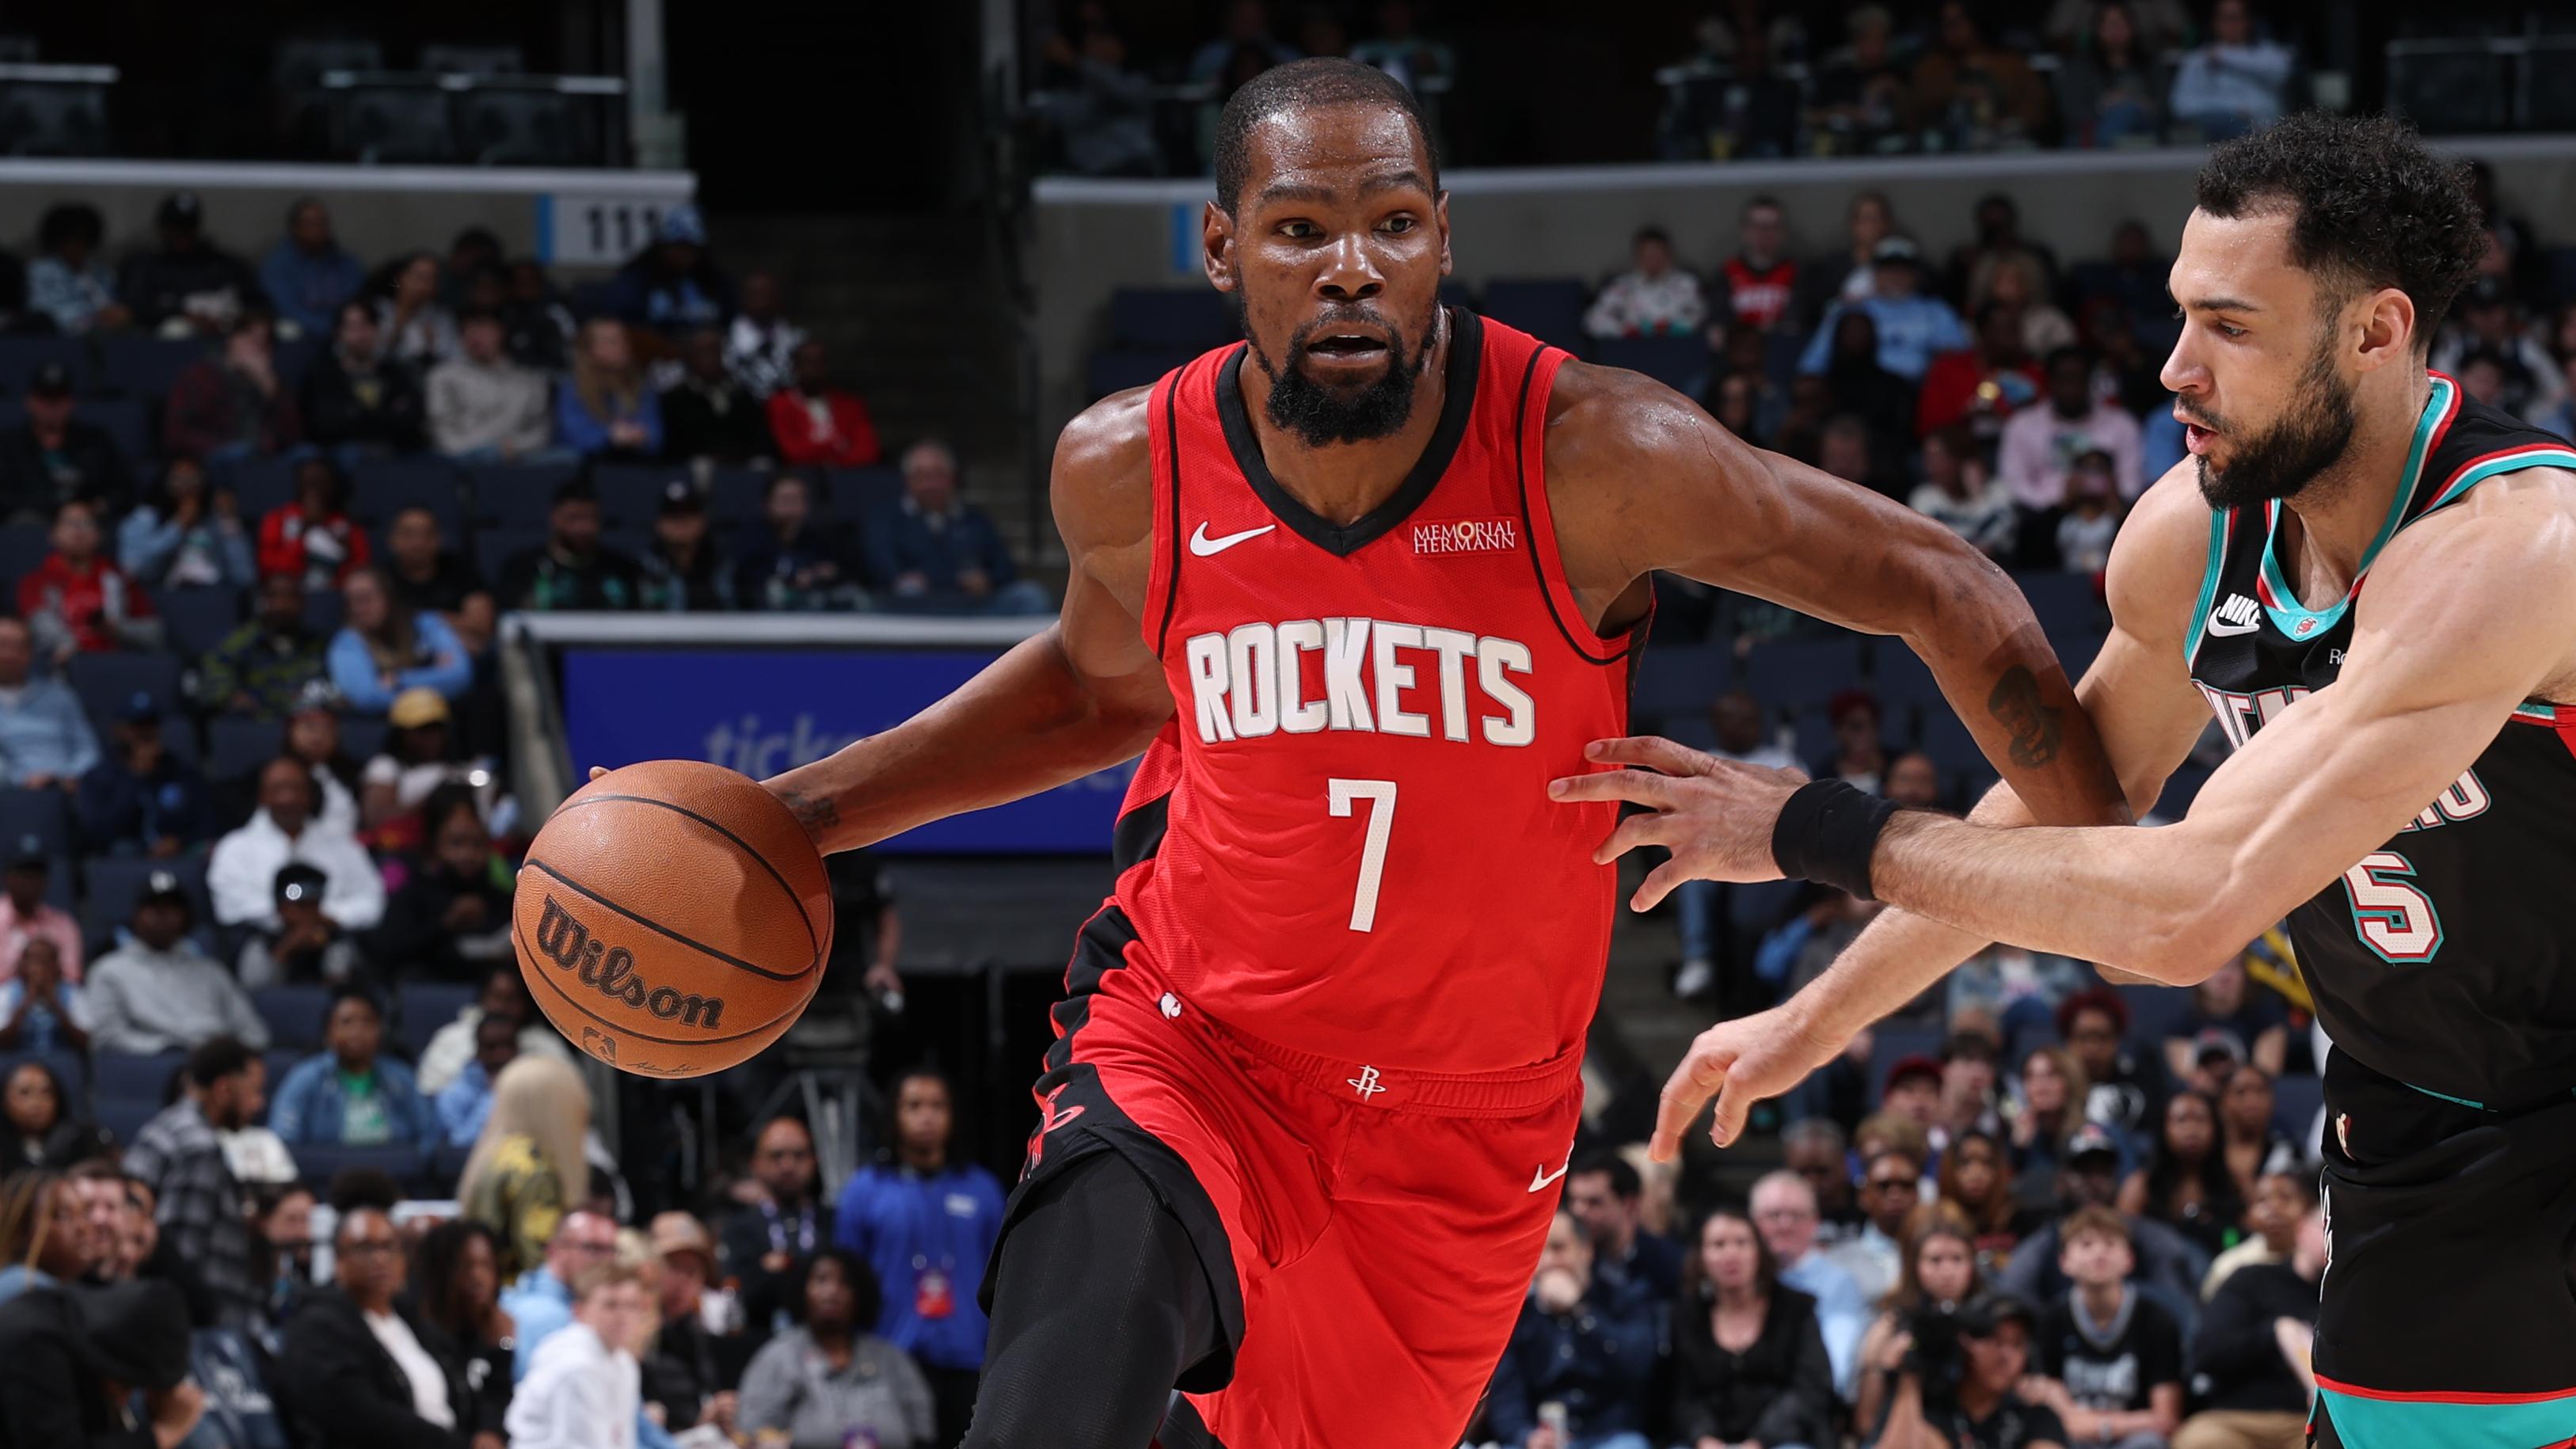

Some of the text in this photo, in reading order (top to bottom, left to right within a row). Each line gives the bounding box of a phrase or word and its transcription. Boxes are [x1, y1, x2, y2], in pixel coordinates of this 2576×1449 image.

[1414, 520, 1516, 541] MEMORIAL
[1414, 533, 1515, 553] HERMANN
[1186, 617, 1535, 747] ROCKETS
[1328, 778, 1397, 933] 7
[2342, 850, 2445, 964] 5
[537, 893, 725, 1029] Wilson
